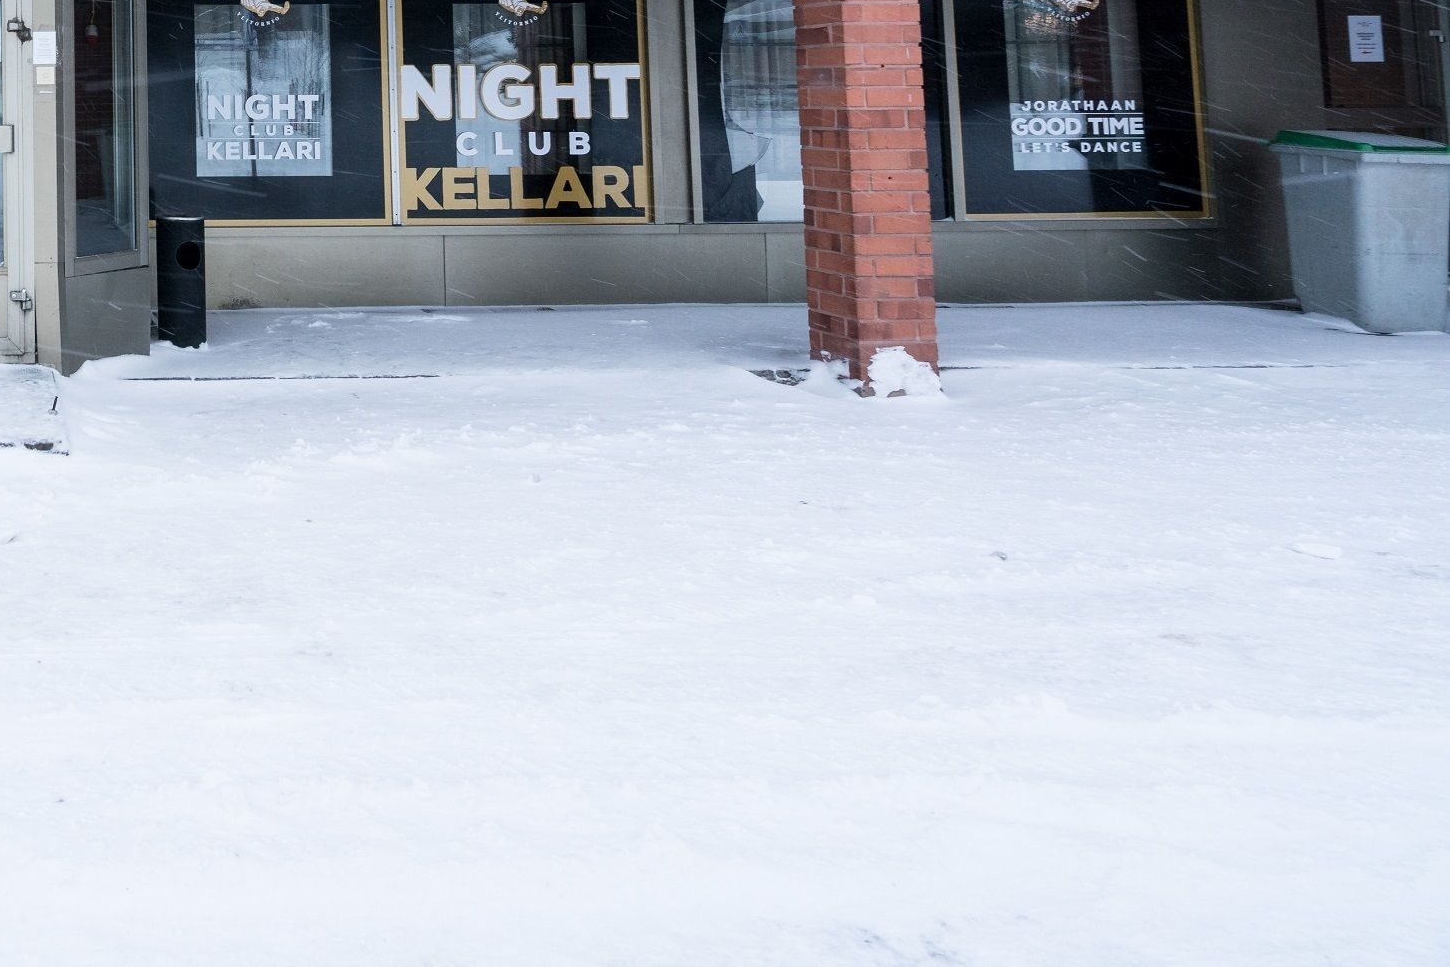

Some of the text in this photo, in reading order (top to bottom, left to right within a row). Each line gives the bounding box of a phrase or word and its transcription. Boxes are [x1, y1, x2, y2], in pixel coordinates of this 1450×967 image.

[401, 63, 641, 121] NIGHT
[207, 94, 319, 120] NIGHT
[1021, 99, 1136, 112] JORATHAAN
[233, 124, 294, 136] CLUB
[1011, 117, 1145, 136] GOOD TIME
[207, 141, 321, 160] KELLARI
[456, 131, 591, 156] CLUB
[1020, 141, 1143, 153] LET'S DANCE
[403, 165, 648, 211] KELLARI
